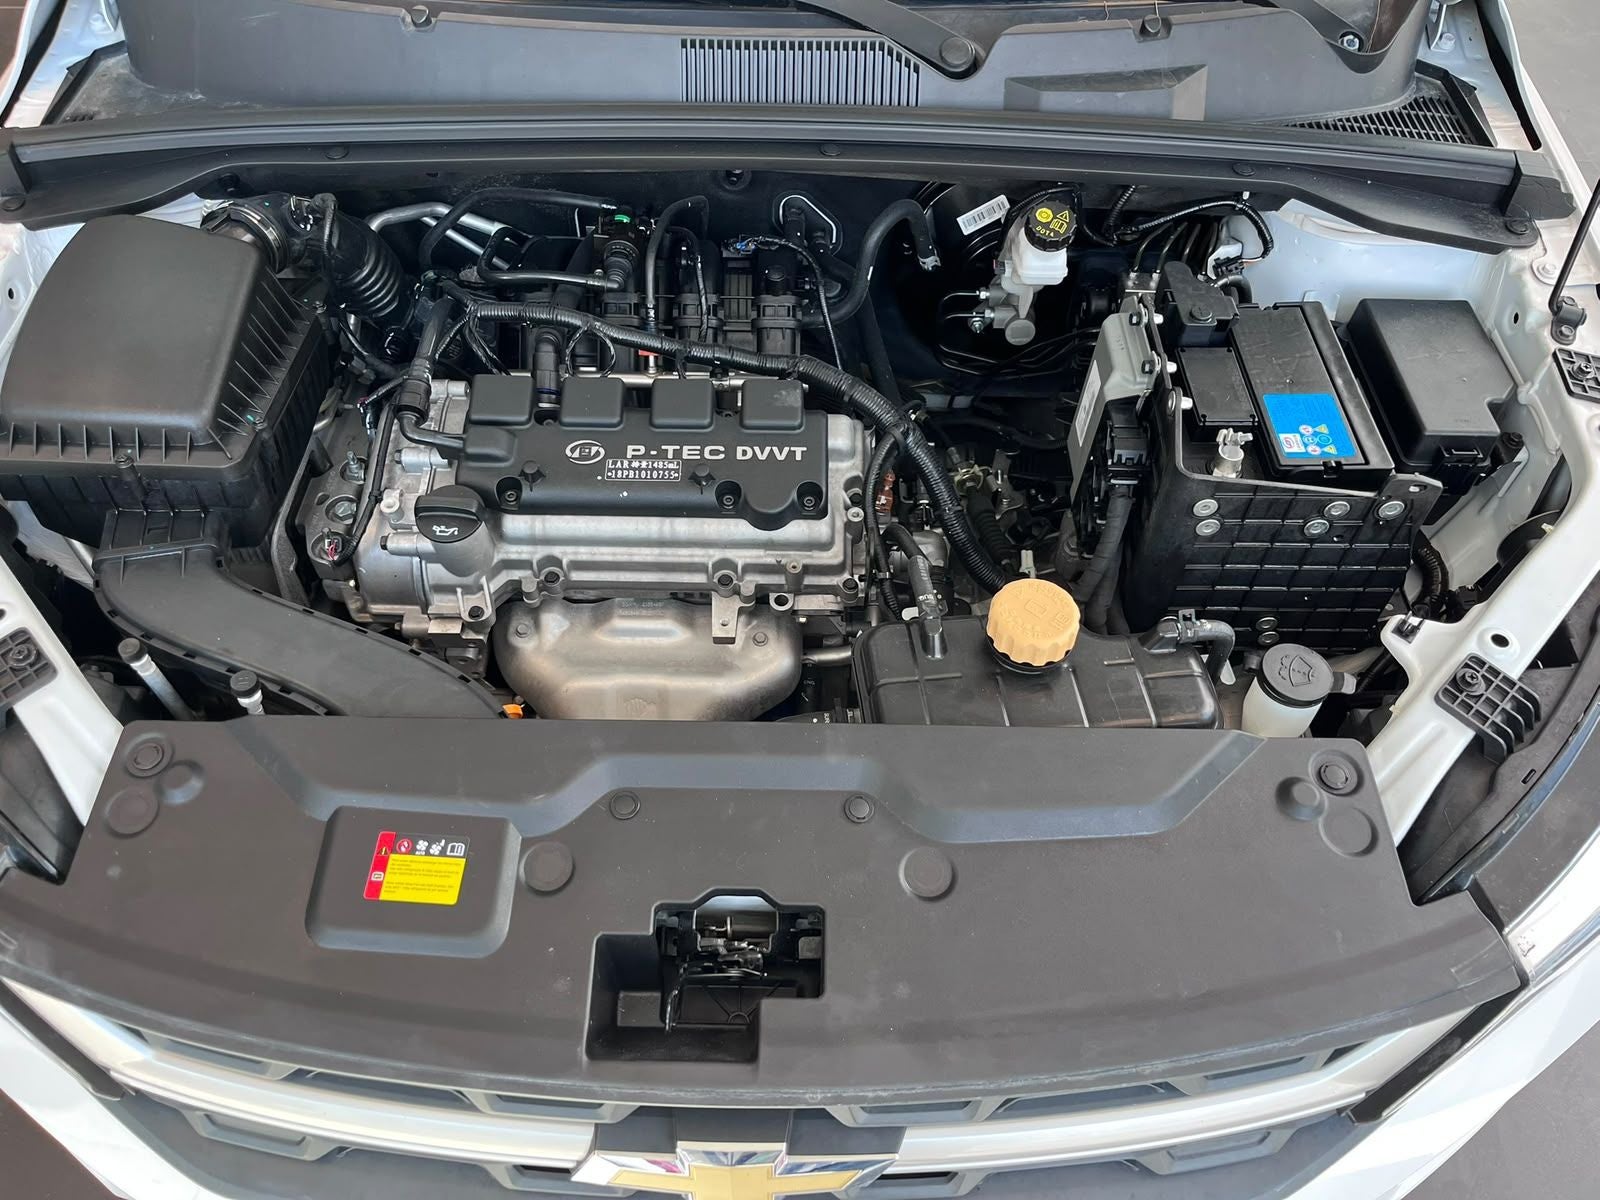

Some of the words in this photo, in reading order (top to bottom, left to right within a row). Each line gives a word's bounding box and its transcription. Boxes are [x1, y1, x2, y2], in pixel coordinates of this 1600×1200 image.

[626, 445, 725, 460] P-TEC
[736, 446, 807, 461] DVVT
[608, 460, 629, 469] LAR
[630, 460, 680, 469] 1485mL
